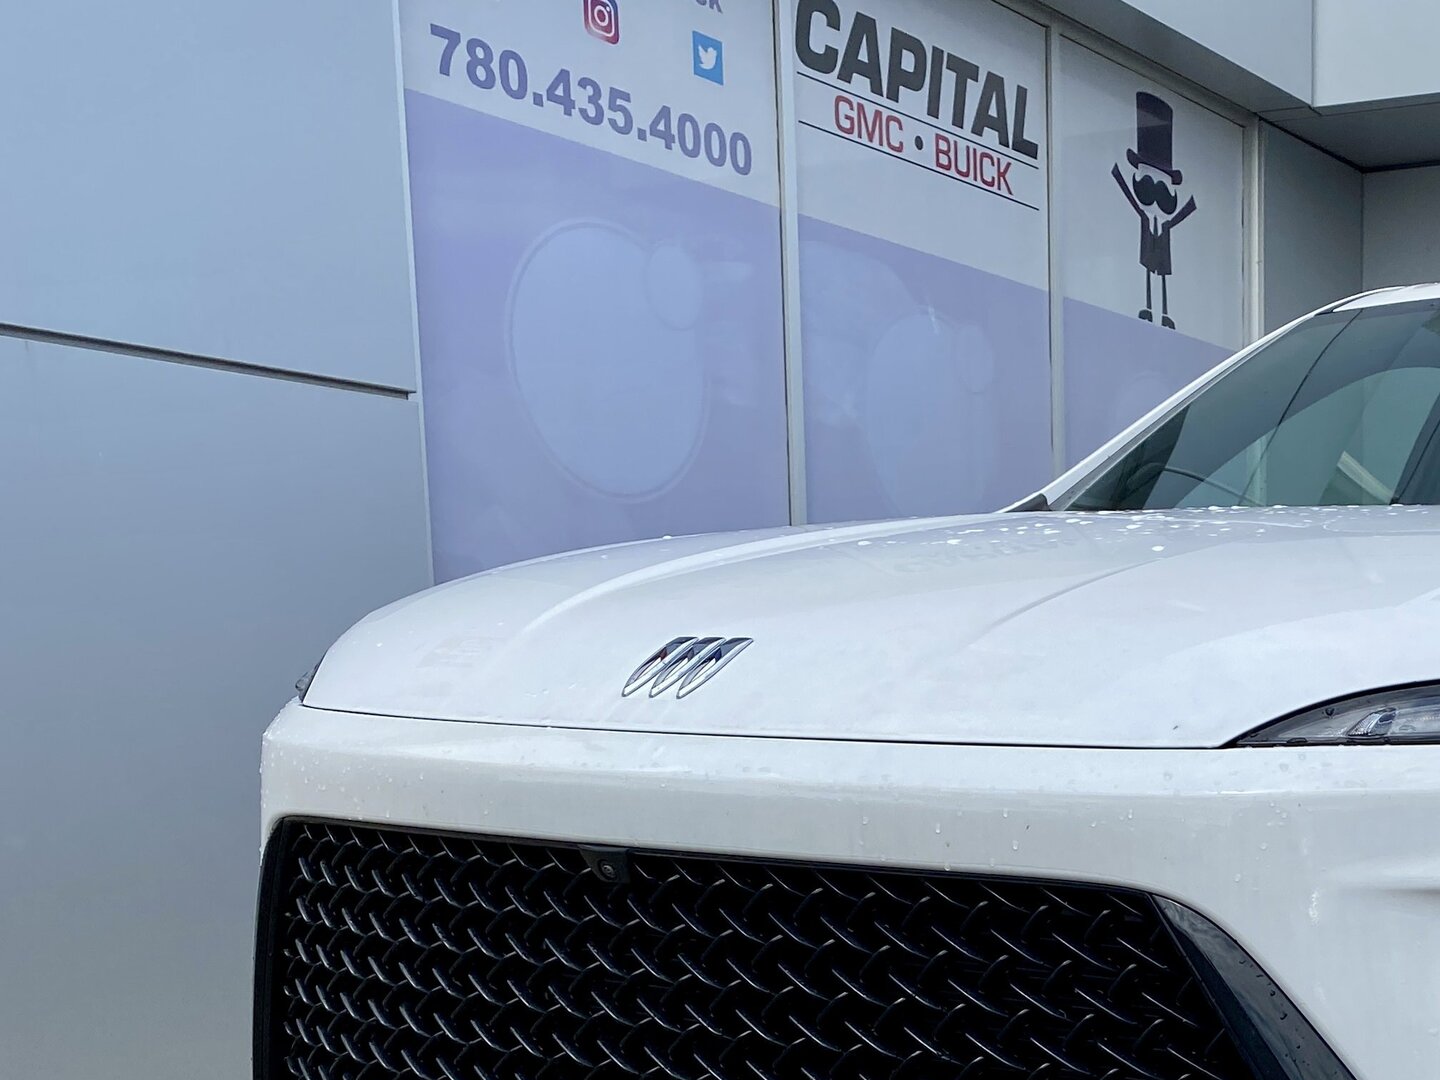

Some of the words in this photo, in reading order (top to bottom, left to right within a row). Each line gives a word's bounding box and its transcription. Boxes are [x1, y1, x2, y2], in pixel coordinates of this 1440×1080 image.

[429, 23, 752, 176] 780.435.4000
[795, 0, 1039, 160] CAPITAL
[834, 94, 905, 153] GMC
[934, 132, 1014, 196] BUICK
